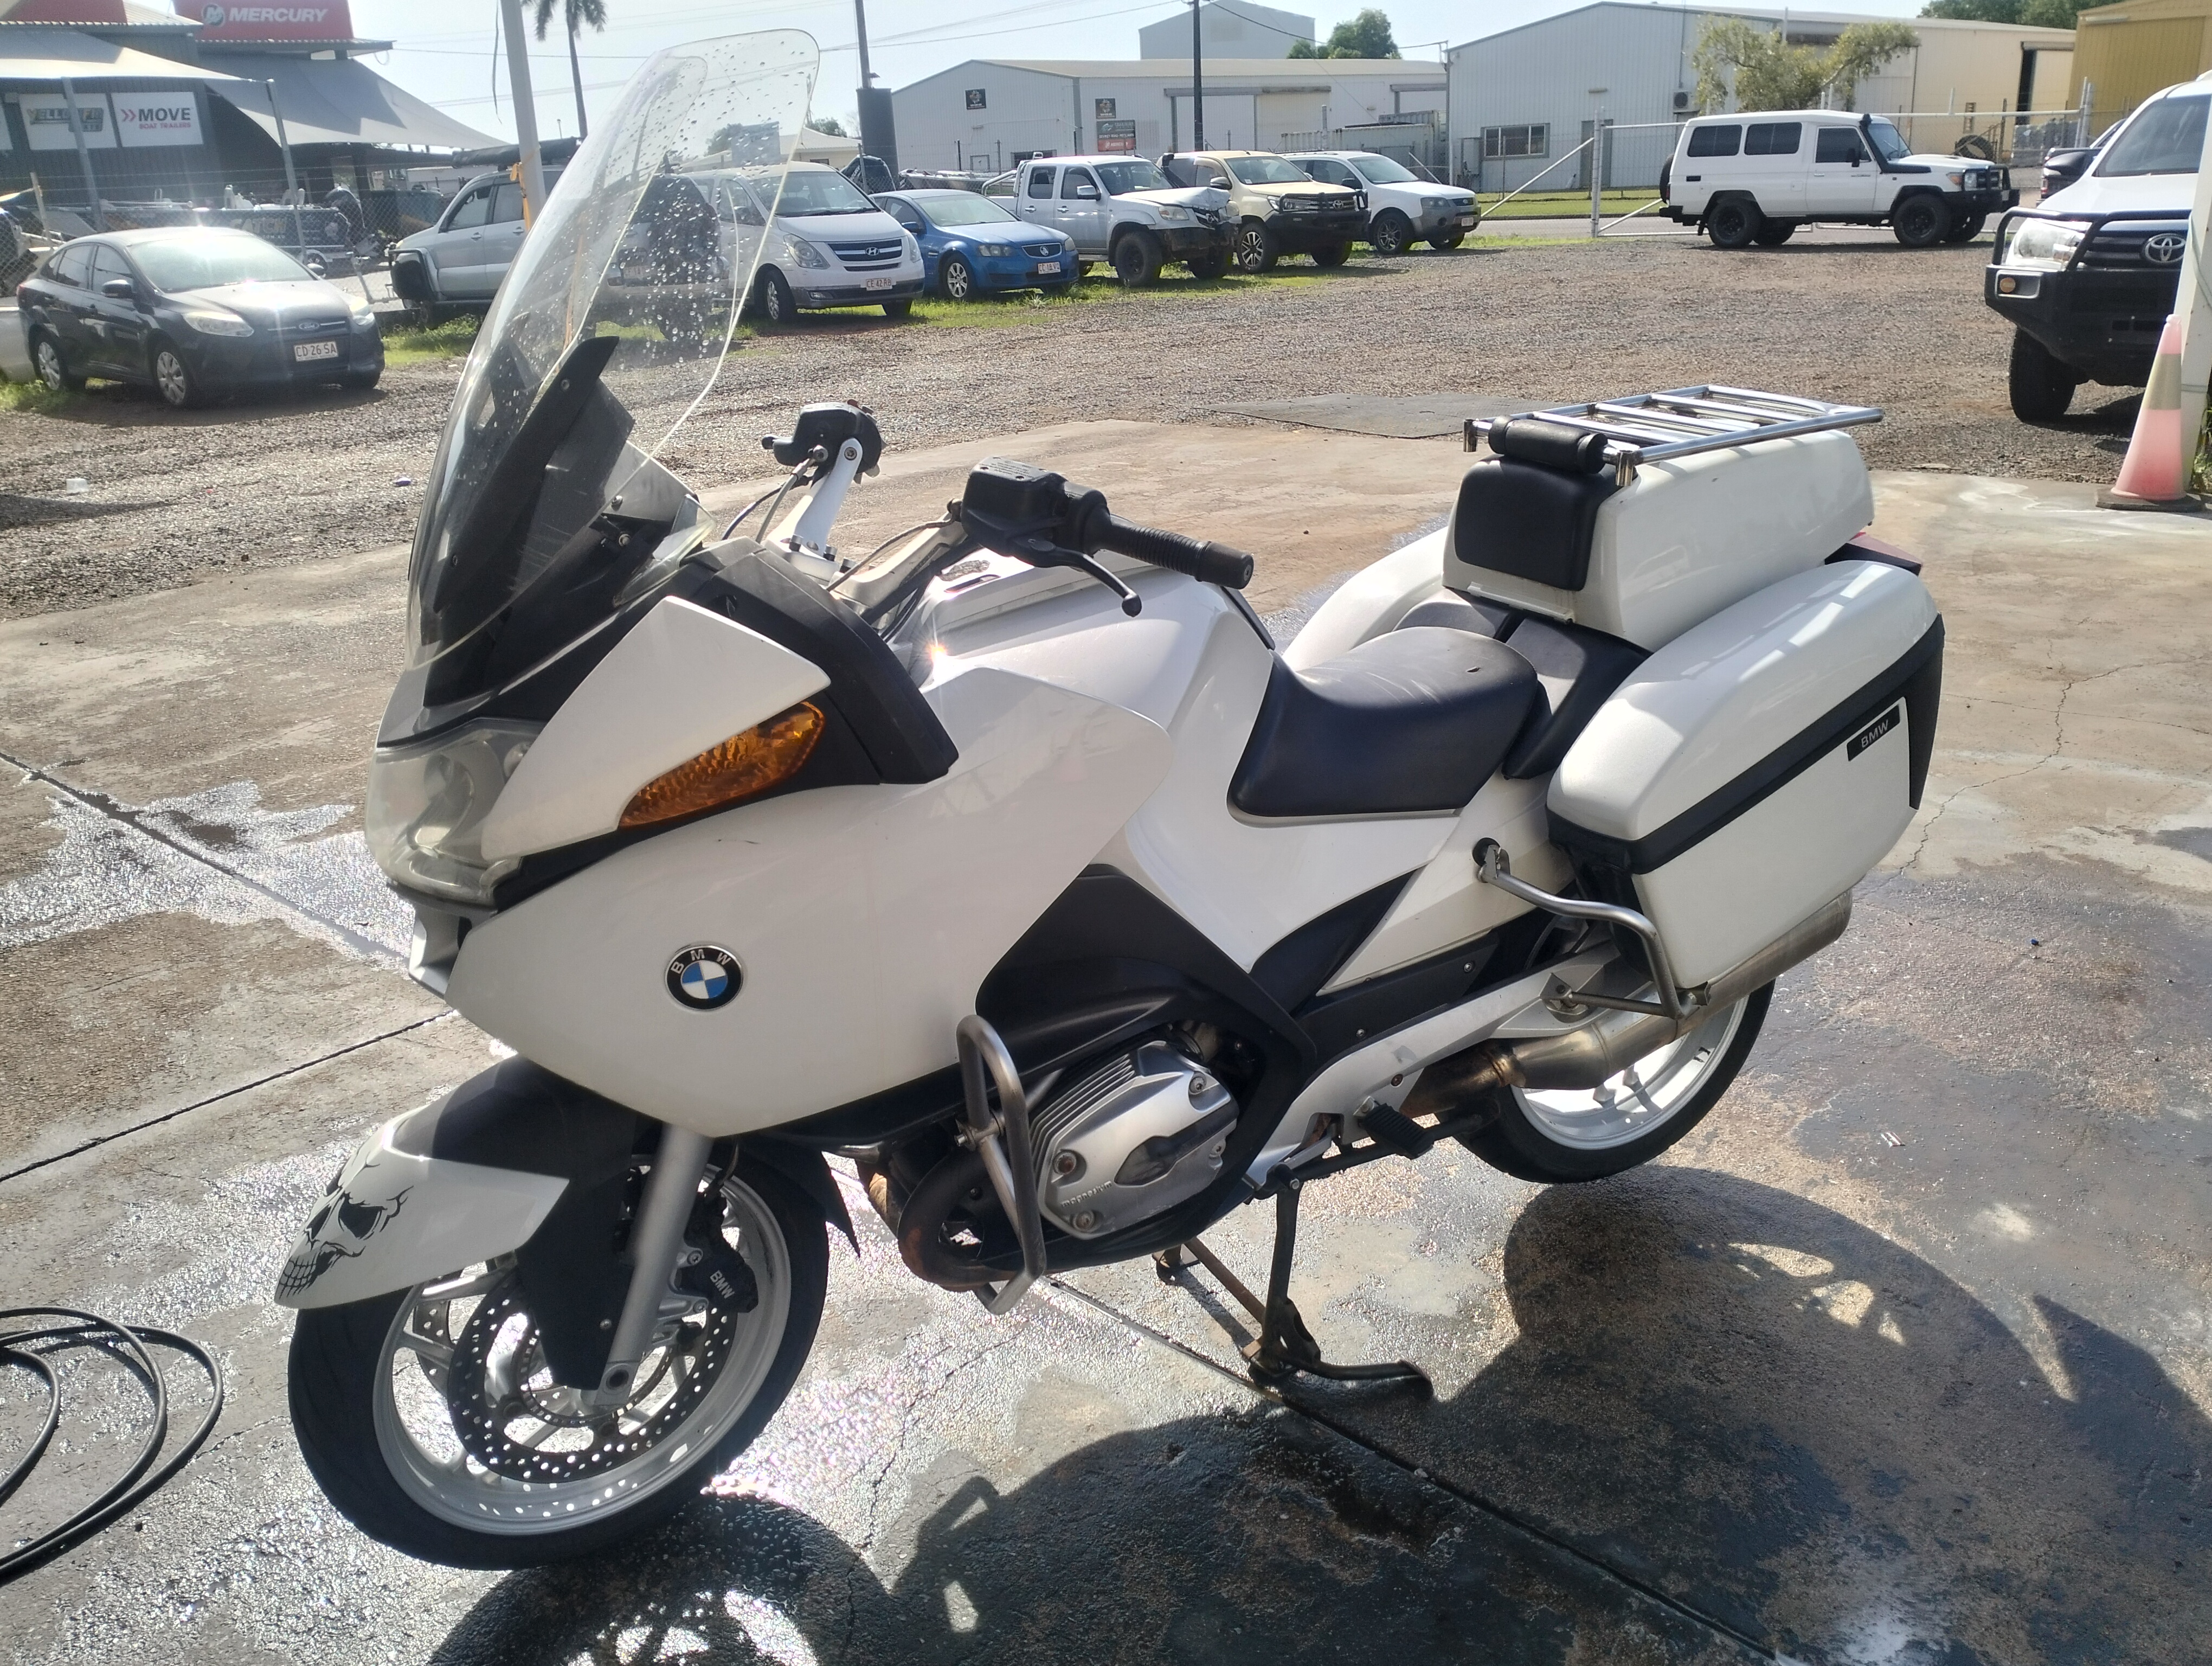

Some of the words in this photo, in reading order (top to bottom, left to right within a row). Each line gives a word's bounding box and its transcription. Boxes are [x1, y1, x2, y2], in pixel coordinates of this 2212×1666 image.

[229, 7, 328, 22] MERCURY
[138, 108, 191, 121] MOVE
[296, 345, 308, 357] CD
[311, 345, 321, 355] 26
[324, 343, 337, 354] SA
[1861, 719, 1888, 748] BMW
[671, 949, 731, 974] BMW
[710, 1270, 735, 1299] BMW
